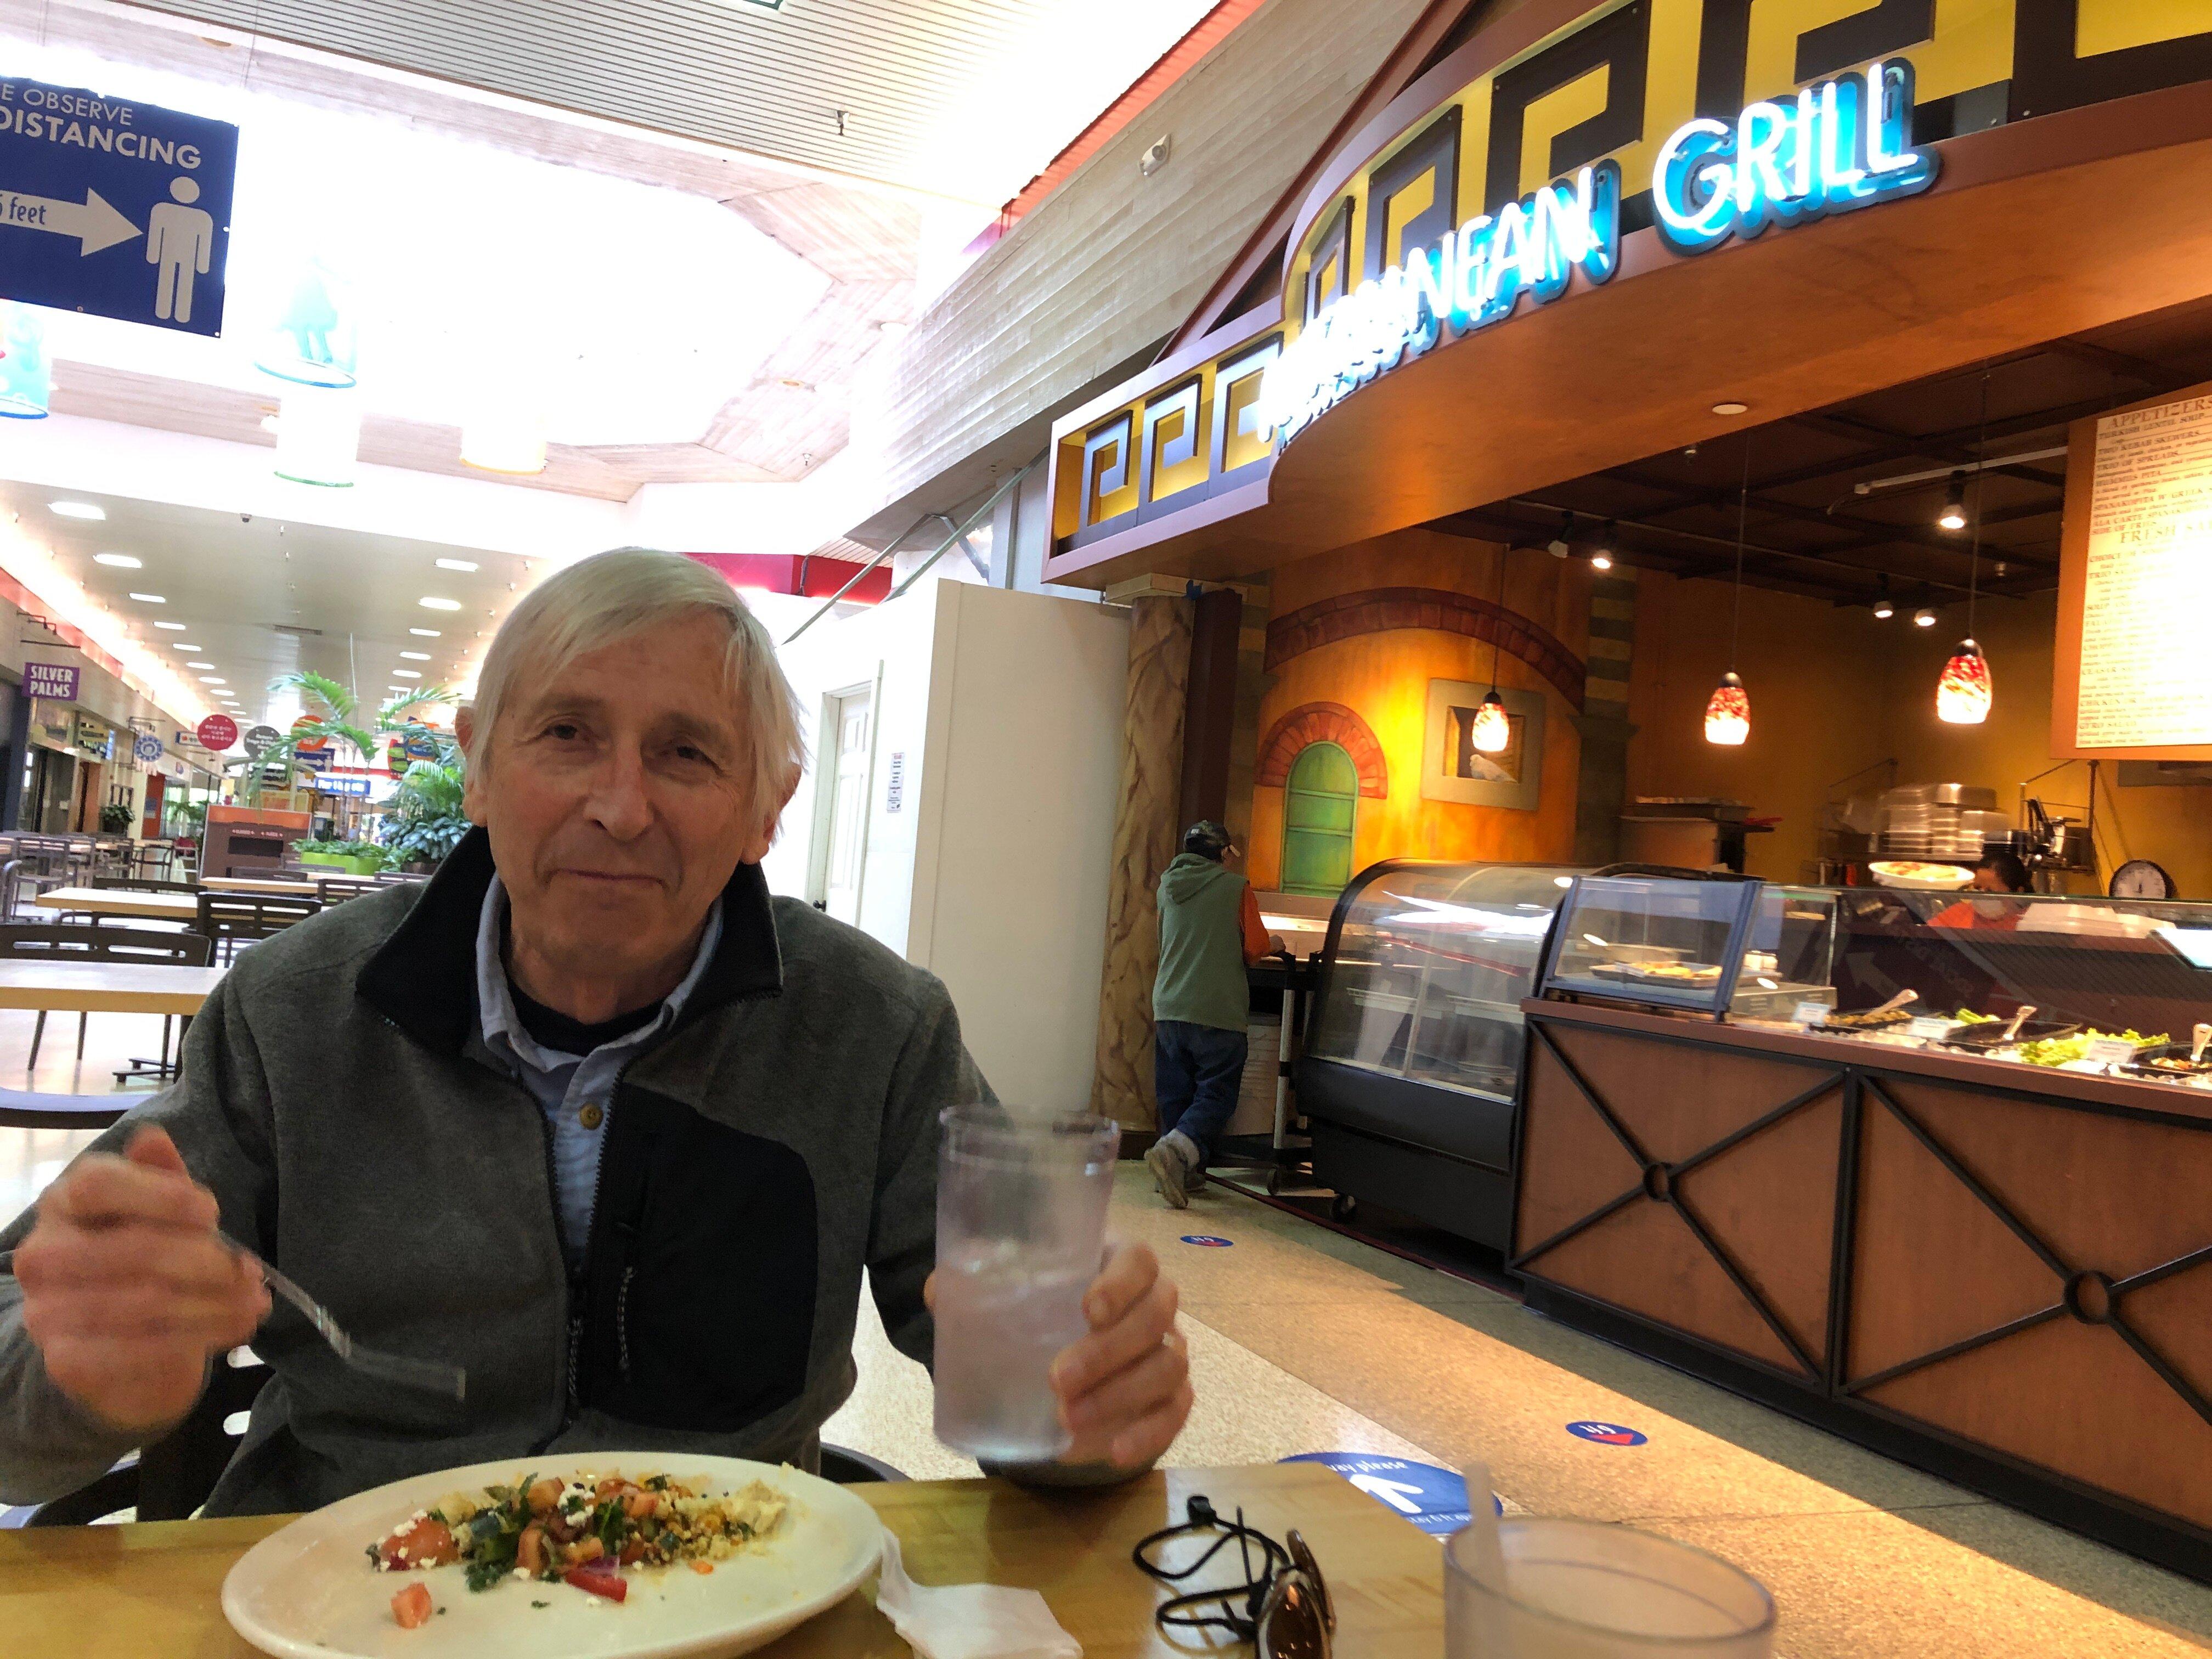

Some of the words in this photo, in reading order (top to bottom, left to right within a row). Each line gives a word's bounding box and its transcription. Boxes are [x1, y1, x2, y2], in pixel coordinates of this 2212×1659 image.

[23, 88, 133, 126] OBSERVE
[0, 105, 201, 169] DISTANCING
[1652, 59, 1934, 244] GRILL
[9, 196, 47, 225] feet
[30, 664, 74, 683] SILVER
[30, 680, 71, 698] PALMS
[1355, 1460, 1409, 1472] please
